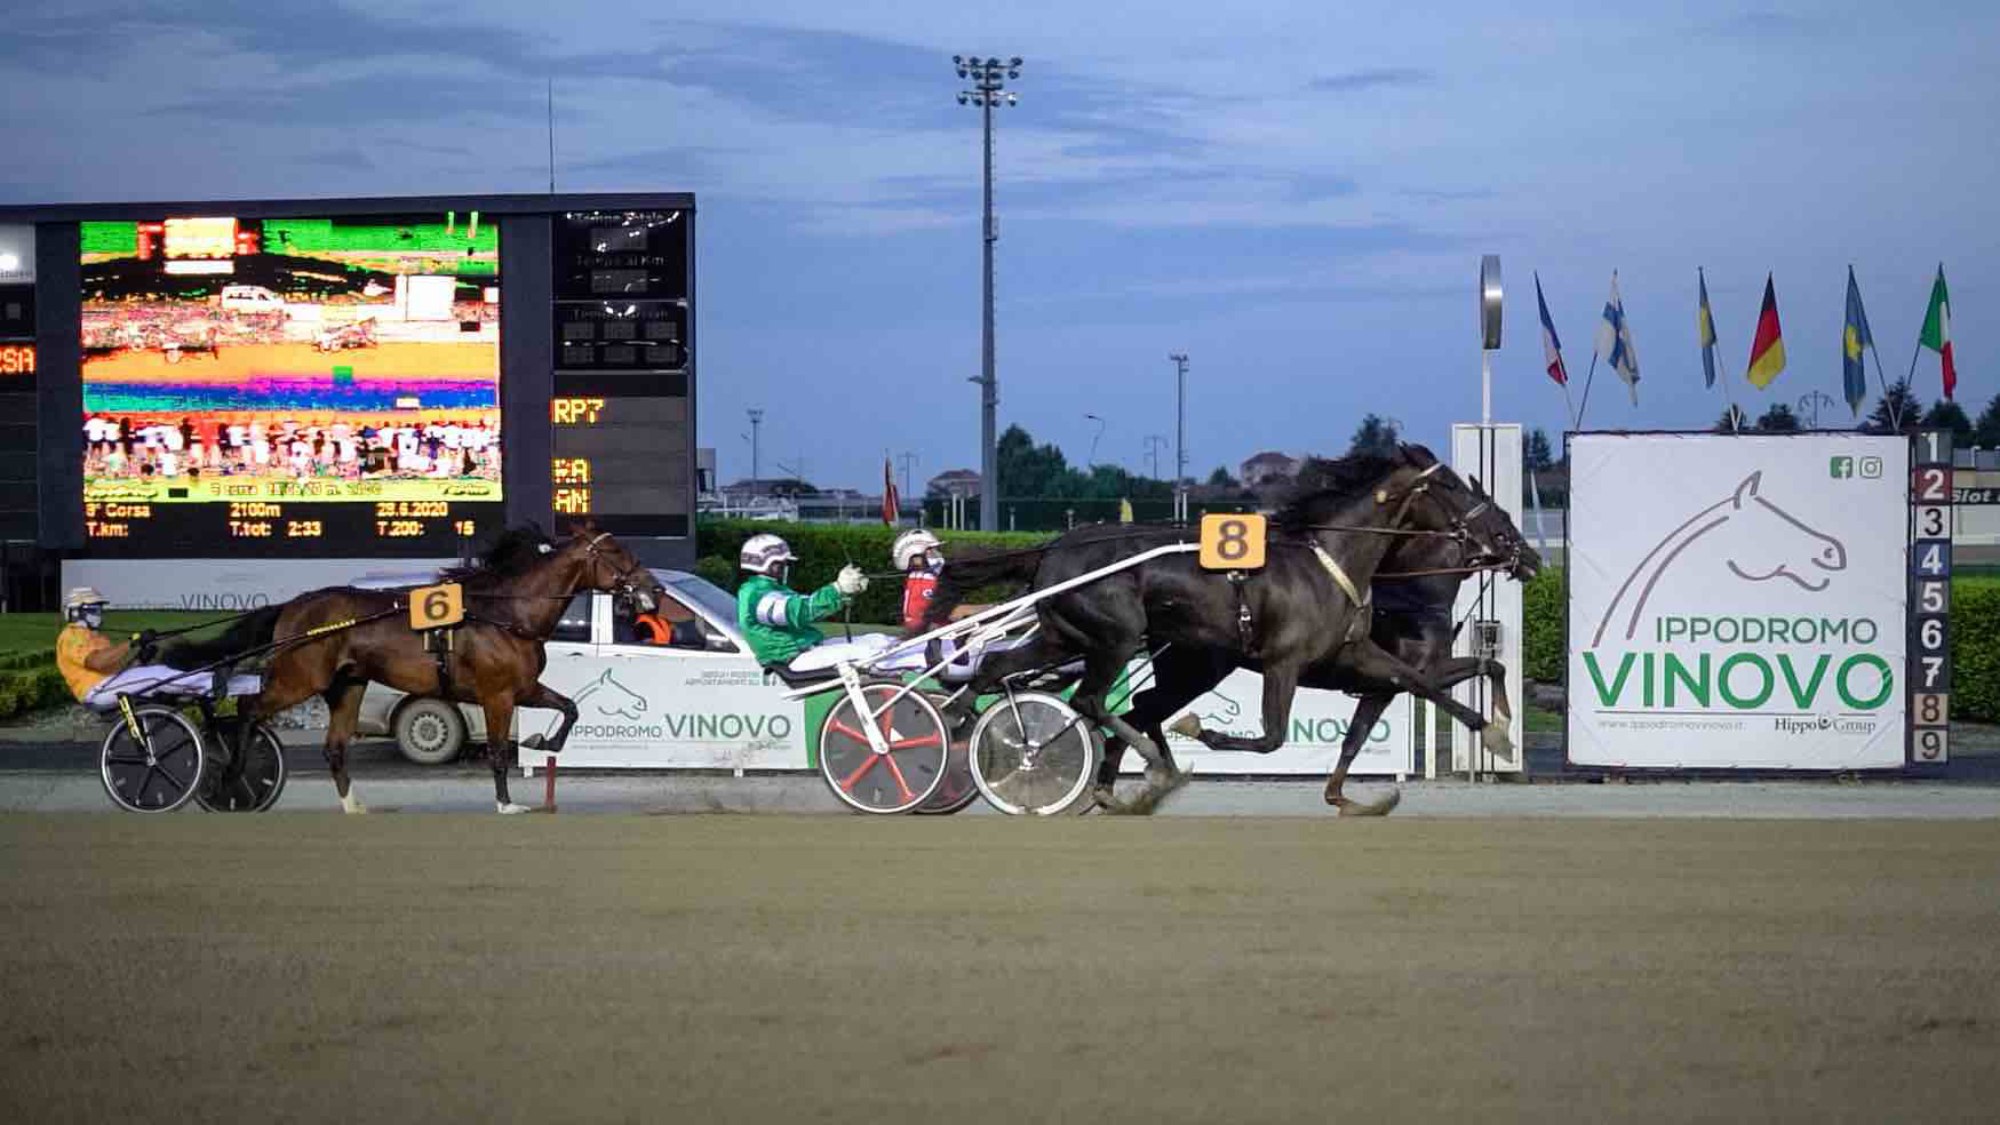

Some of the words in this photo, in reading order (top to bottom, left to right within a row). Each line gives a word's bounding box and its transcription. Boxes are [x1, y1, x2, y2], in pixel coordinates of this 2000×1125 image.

[0, 346, 35, 374] SA
[1921, 432, 1938, 462] 1
[1923, 469, 1944, 499] 2
[1952, 489, 1991, 504] Slot
[106, 503, 150, 517] Corsa
[230, 502, 280, 517] 2100m
[1924, 508, 1943, 536] 3
[288, 521, 321, 536] 2:33
[1217, 520, 1248, 560] 8
[1921, 544, 1942, 575] 4
[180, 593, 269, 612] VINOVO
[424, 591, 449, 620] 6
[1922, 581, 1943, 612] 5
[1656, 616, 1878, 644] IPPODROMO
[1921, 619, 1942, 649] 6
[1582, 651, 1895, 710] VINOVO
[1921, 657, 1944, 687] 7
[1921, 693, 1940, 722] 8
[664, 713, 792, 739] VINOVO
[1921, 731, 1941, 760] 9
